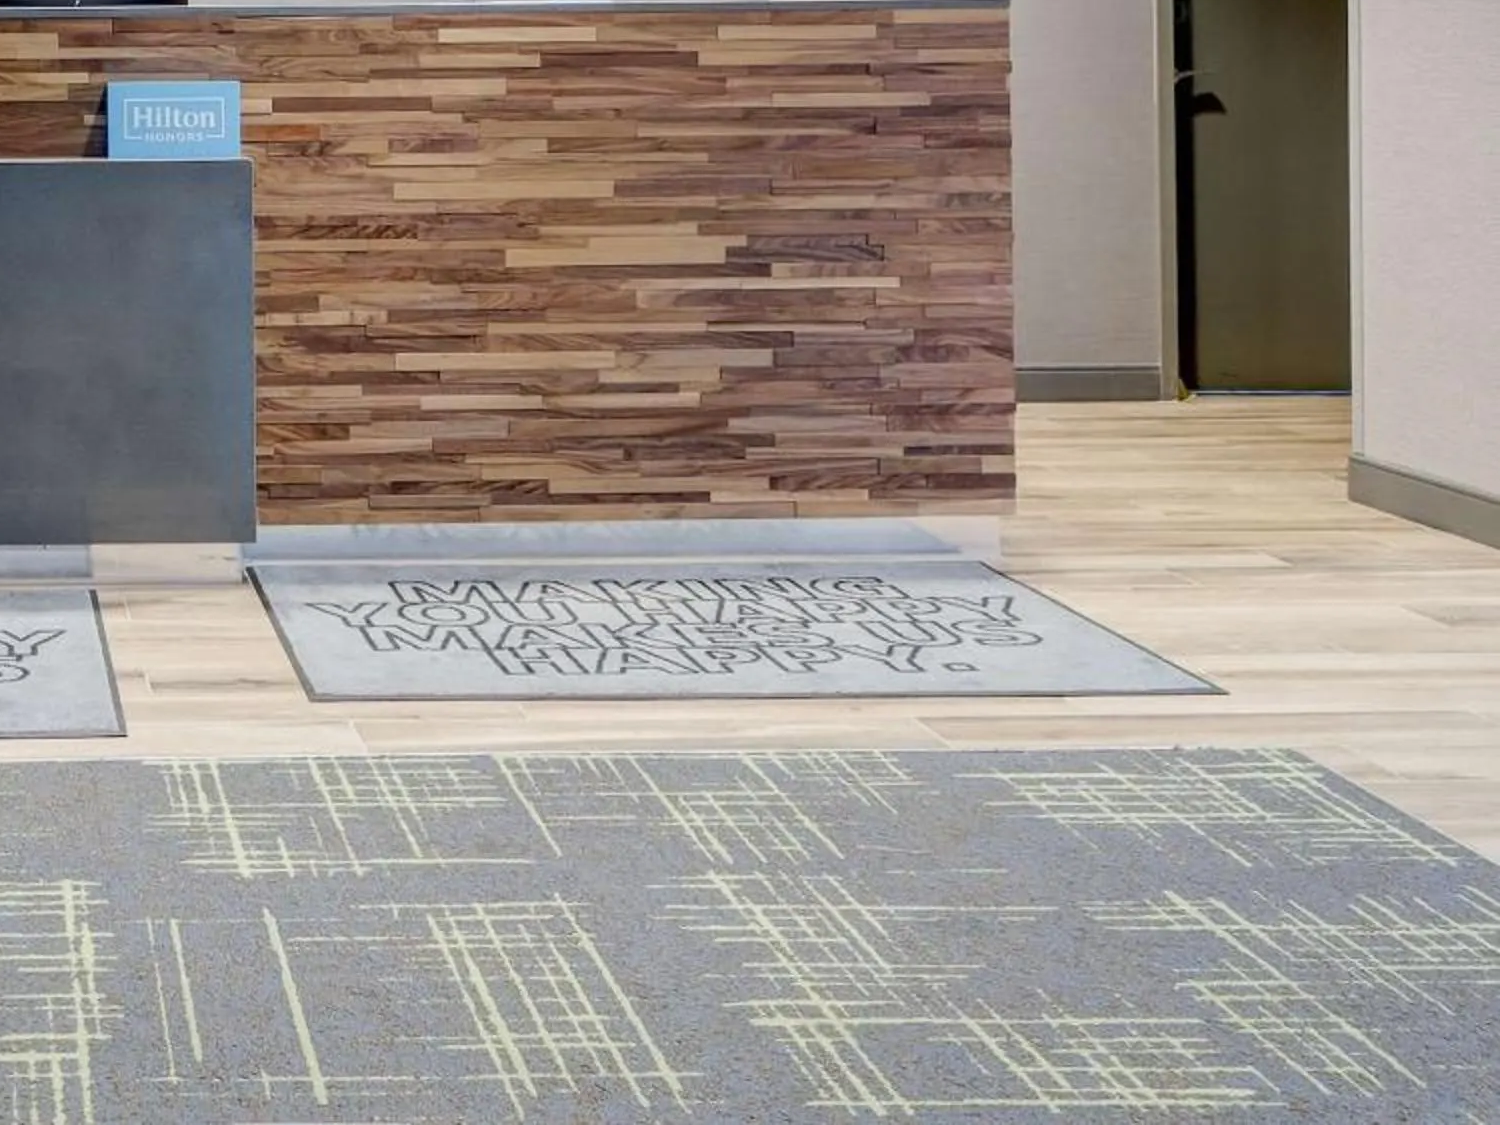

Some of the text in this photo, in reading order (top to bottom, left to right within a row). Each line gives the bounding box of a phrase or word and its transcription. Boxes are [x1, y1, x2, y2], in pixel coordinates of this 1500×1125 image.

[132, 106, 216, 129] Hilton
[144, 131, 204, 143] HONORS
[388, 576, 910, 604] MAKING
[304, 596, 1021, 627] YOU HAPPY
[360, 619, 1043, 651] MAKES US
[483, 644, 980, 675] HAPPY.
